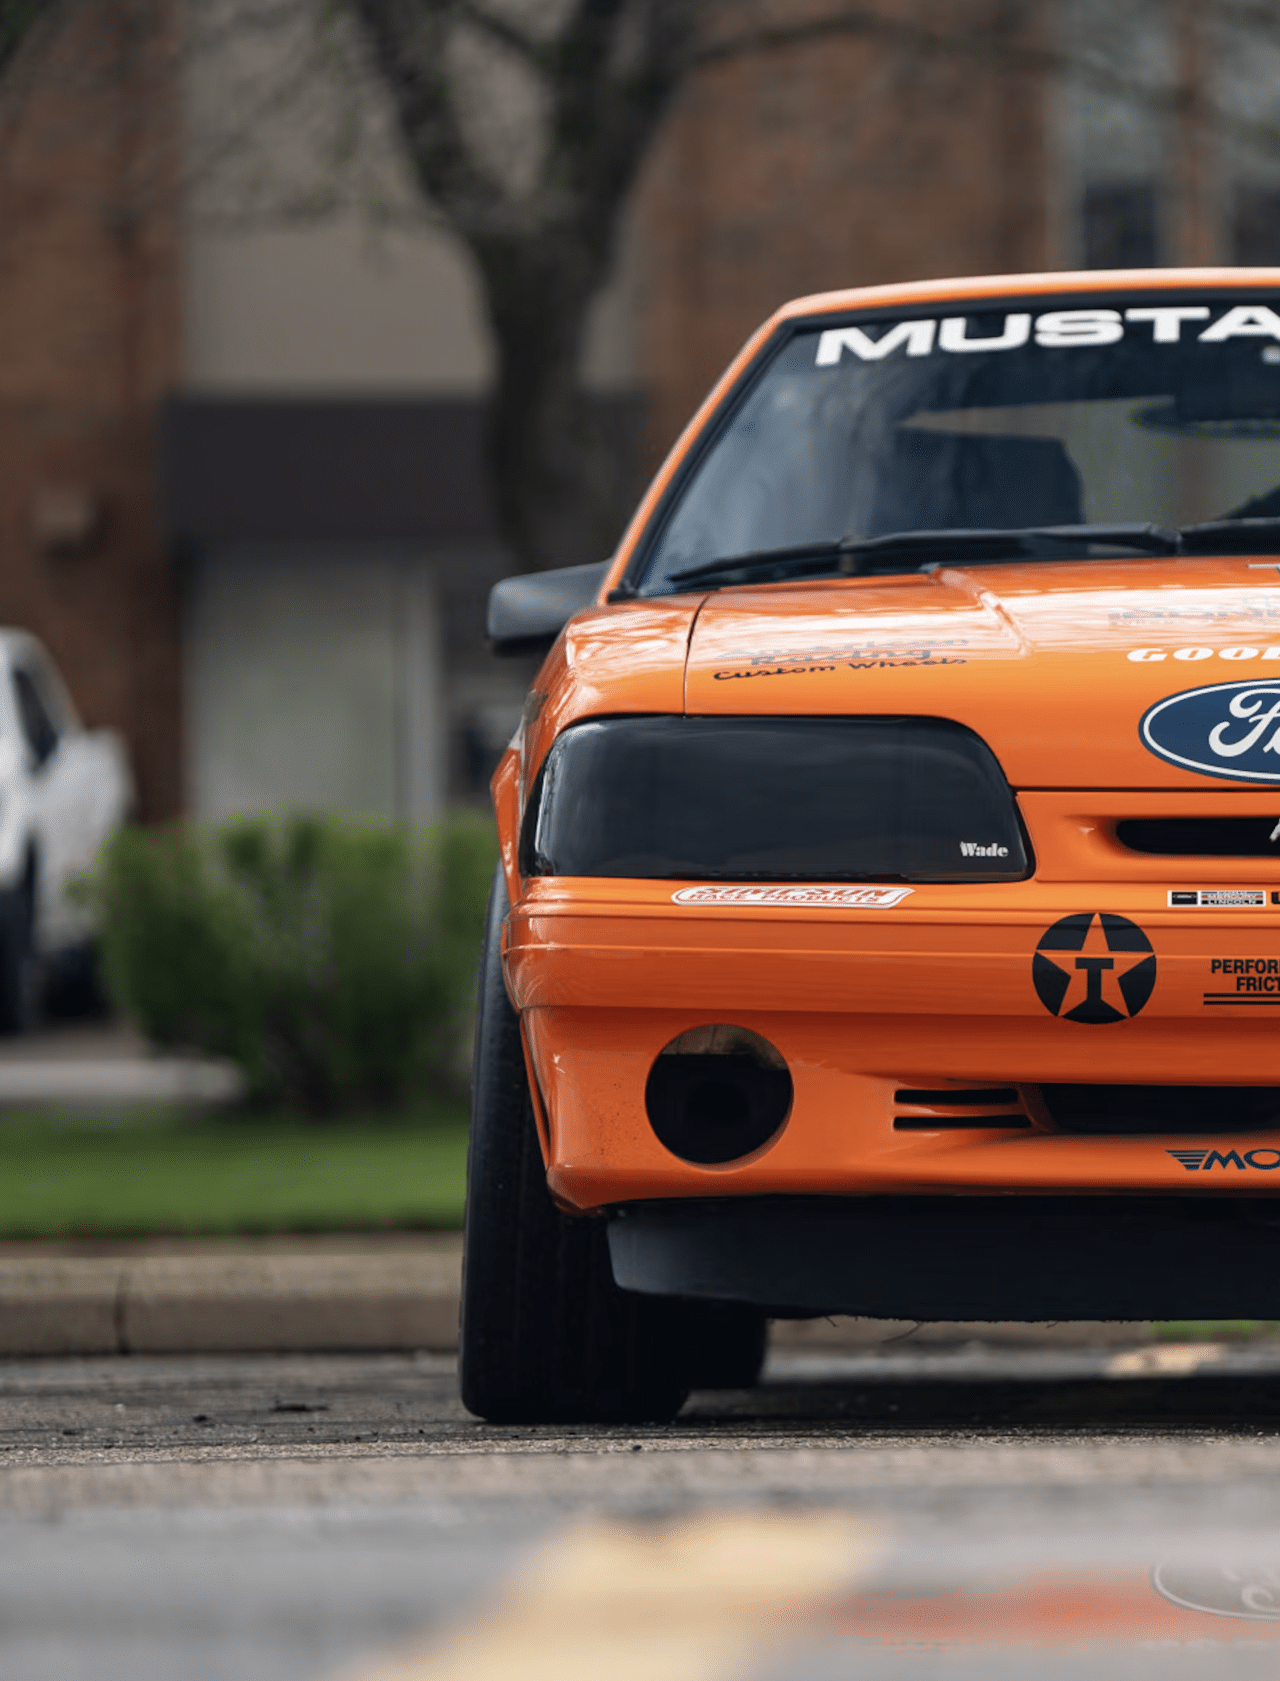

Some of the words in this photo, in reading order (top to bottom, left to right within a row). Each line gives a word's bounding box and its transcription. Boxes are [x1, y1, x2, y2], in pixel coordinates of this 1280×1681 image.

[750, 649, 931, 666] Racing
[713, 664, 836, 681] Custom
[848, 657, 967, 671] Wheels
[959, 842, 1009, 857] Wade
